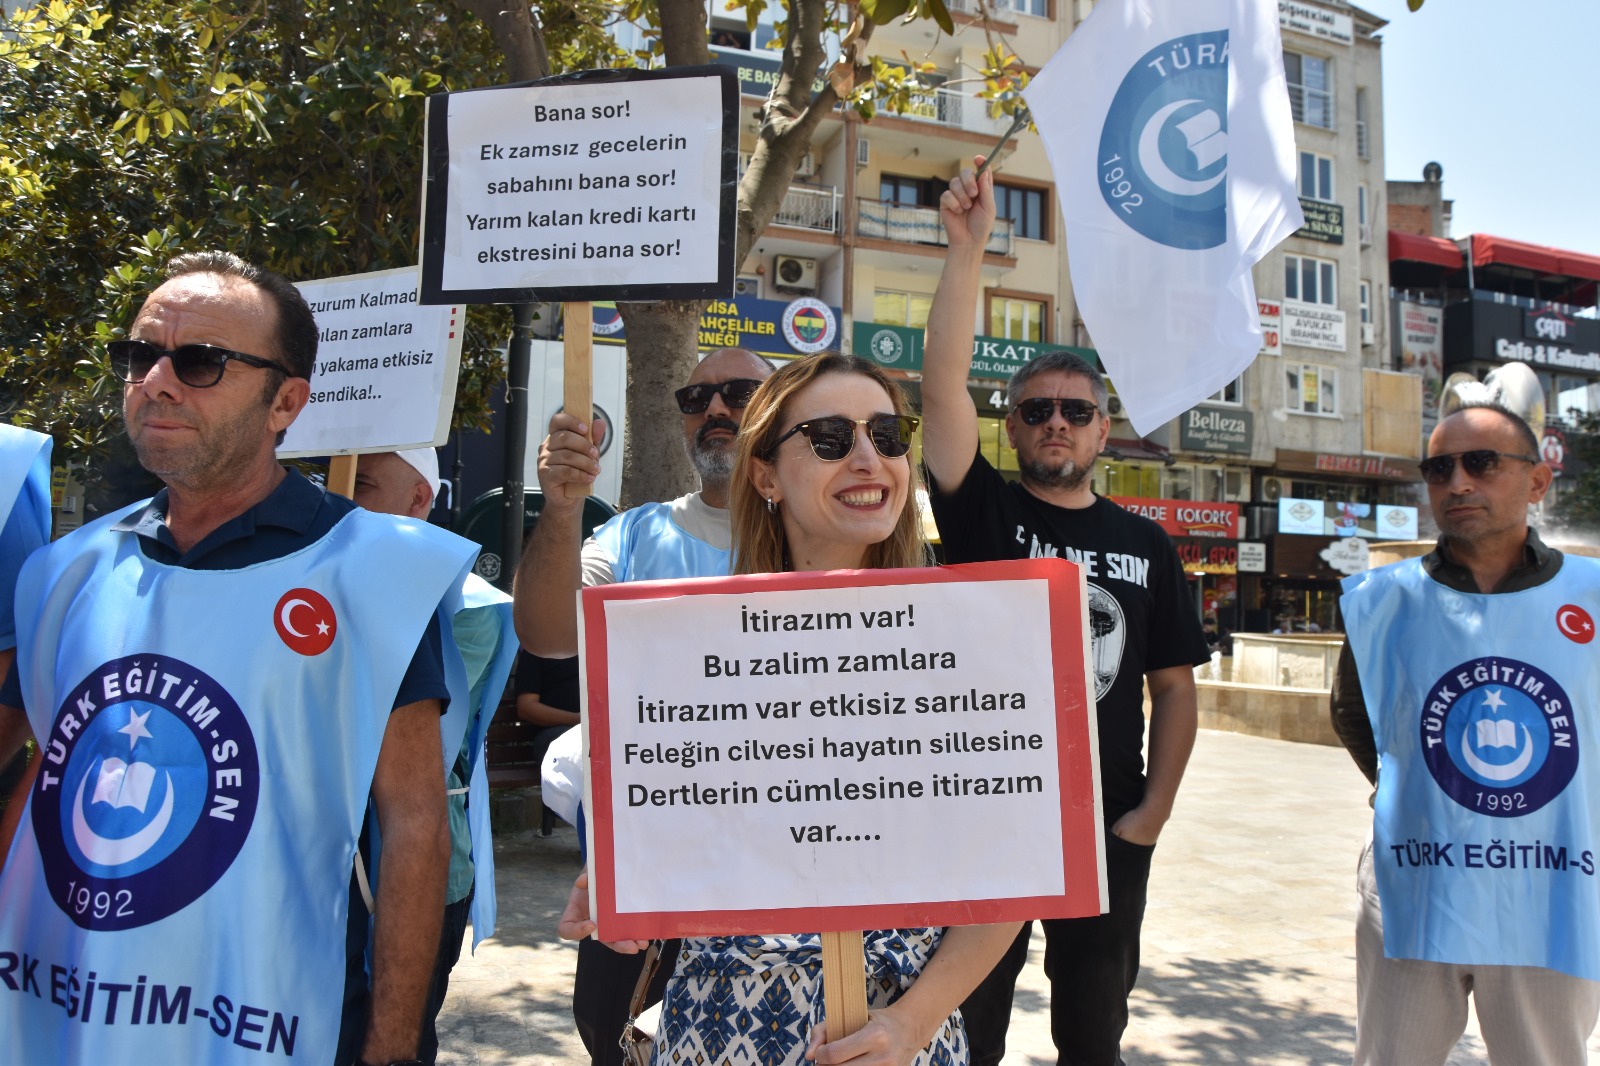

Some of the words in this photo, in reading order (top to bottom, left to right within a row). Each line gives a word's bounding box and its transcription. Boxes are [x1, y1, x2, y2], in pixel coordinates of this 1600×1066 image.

[535, 106, 585, 122] Bana
[592, 100, 630, 118] sor!
[481, 144, 503, 160] Ek
[509, 144, 578, 158] zamsız
[589, 134, 686, 158] gecelerin
[488, 176, 572, 194] sabahını
[580, 174, 629, 189] bana
[637, 170, 675, 187] sor!
[1104, 153, 1142, 214] 1992
[467, 215, 521, 230] Yarım
[528, 210, 582, 227] kalan
[590, 207, 641, 224] kredi
[649, 206, 695, 222] kartı
[478, 243, 576, 263] ekstresini
[583, 242, 633, 258] bana
[641, 239, 680, 256] sor!
[310, 298, 355, 313] zurum
[360, 288, 417, 308] Kalmad
[321, 328, 347, 342] ılan
[352, 322, 412, 339] zamlara
[700, 317, 775, 335] AHÇELİLER
[1296, 319, 1333, 331] AVUKAT
[699, 331, 740, 347] RNEĞİ
[1496, 338, 1533, 361] Cafe
[1534, 345, 1546, 363] &
[320, 357, 378, 376] yakama
[383, 350, 433, 367] etkisiz
[1188, 410, 1246, 433] Belleza
[1105, 552, 1150, 588] SON
[742, 605, 851, 632] İtirazım
[860, 605, 914, 628] var!
[705, 655, 740, 677] Bu
[750, 652, 828, 675] zalim
[838, 648, 955, 672] zamlara
[638, 695, 747, 723] İtirazım
[755, 701, 801, 719] var
[810, 692, 906, 717] etkisiz
[915, 689, 1025, 713] sarılara
[1423, 685, 1457, 748] TÜRK
[1456, 660, 1571, 748] EĞİTİM-SEN
[41, 690, 96, 791] TÜRK
[103, 660, 242, 822] EĞİTİM-SEN
[625, 741, 719, 768] Feleğin
[728, 738, 813, 761] cilvesi
[823, 737, 921, 762] hayatın
[930, 730, 1042, 754] sillesine
[629, 781, 757, 806] Dertlerin
[767, 776, 923, 802] cümlesine
[933, 773, 1042, 796] itirazım
[1475, 792, 1527, 811] 1992
[790, 825, 880, 843] var.....
[1391, 839, 1454, 868] TÜRK
[1464, 839, 1595, 876] EĞİTİM-S
[66, 880, 135, 919] 1992
[0, 951, 41, 999] RK
[51, 964, 299, 1057] EĞİTİM-SEN
